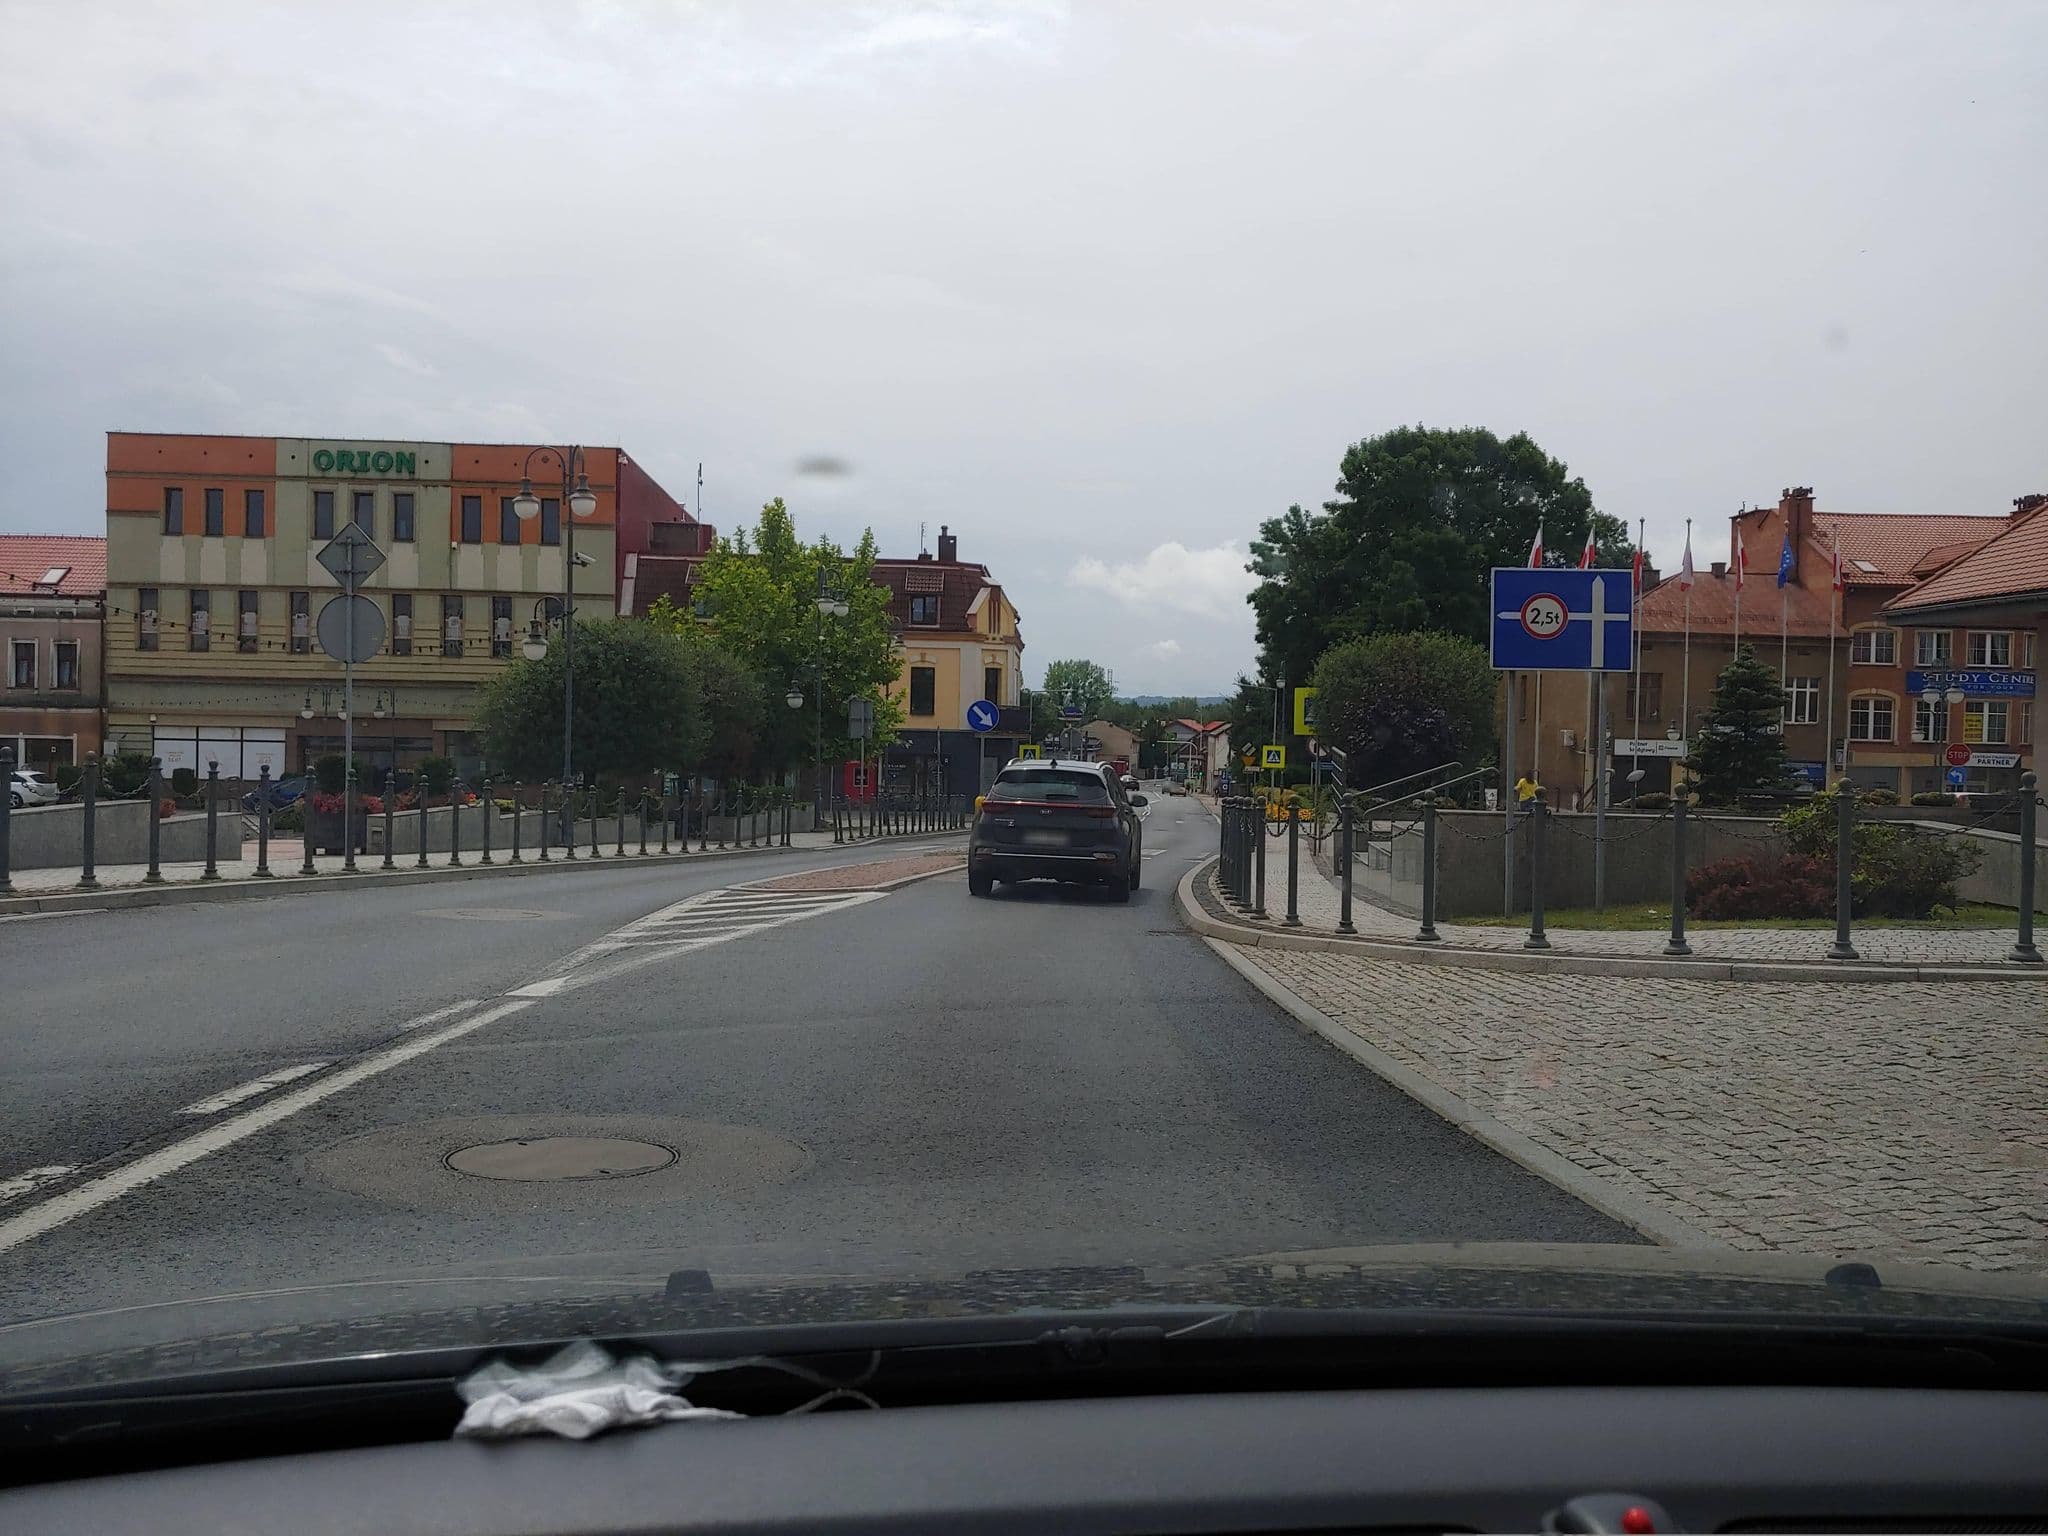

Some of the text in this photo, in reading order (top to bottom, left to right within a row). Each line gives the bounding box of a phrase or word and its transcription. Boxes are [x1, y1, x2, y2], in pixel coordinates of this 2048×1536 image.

[313, 449, 416, 474] ORION
[1530, 608, 1560, 626] 2,5t
[1922, 671, 1981, 682] STUDY
[1948, 751, 1969, 759] STOP
